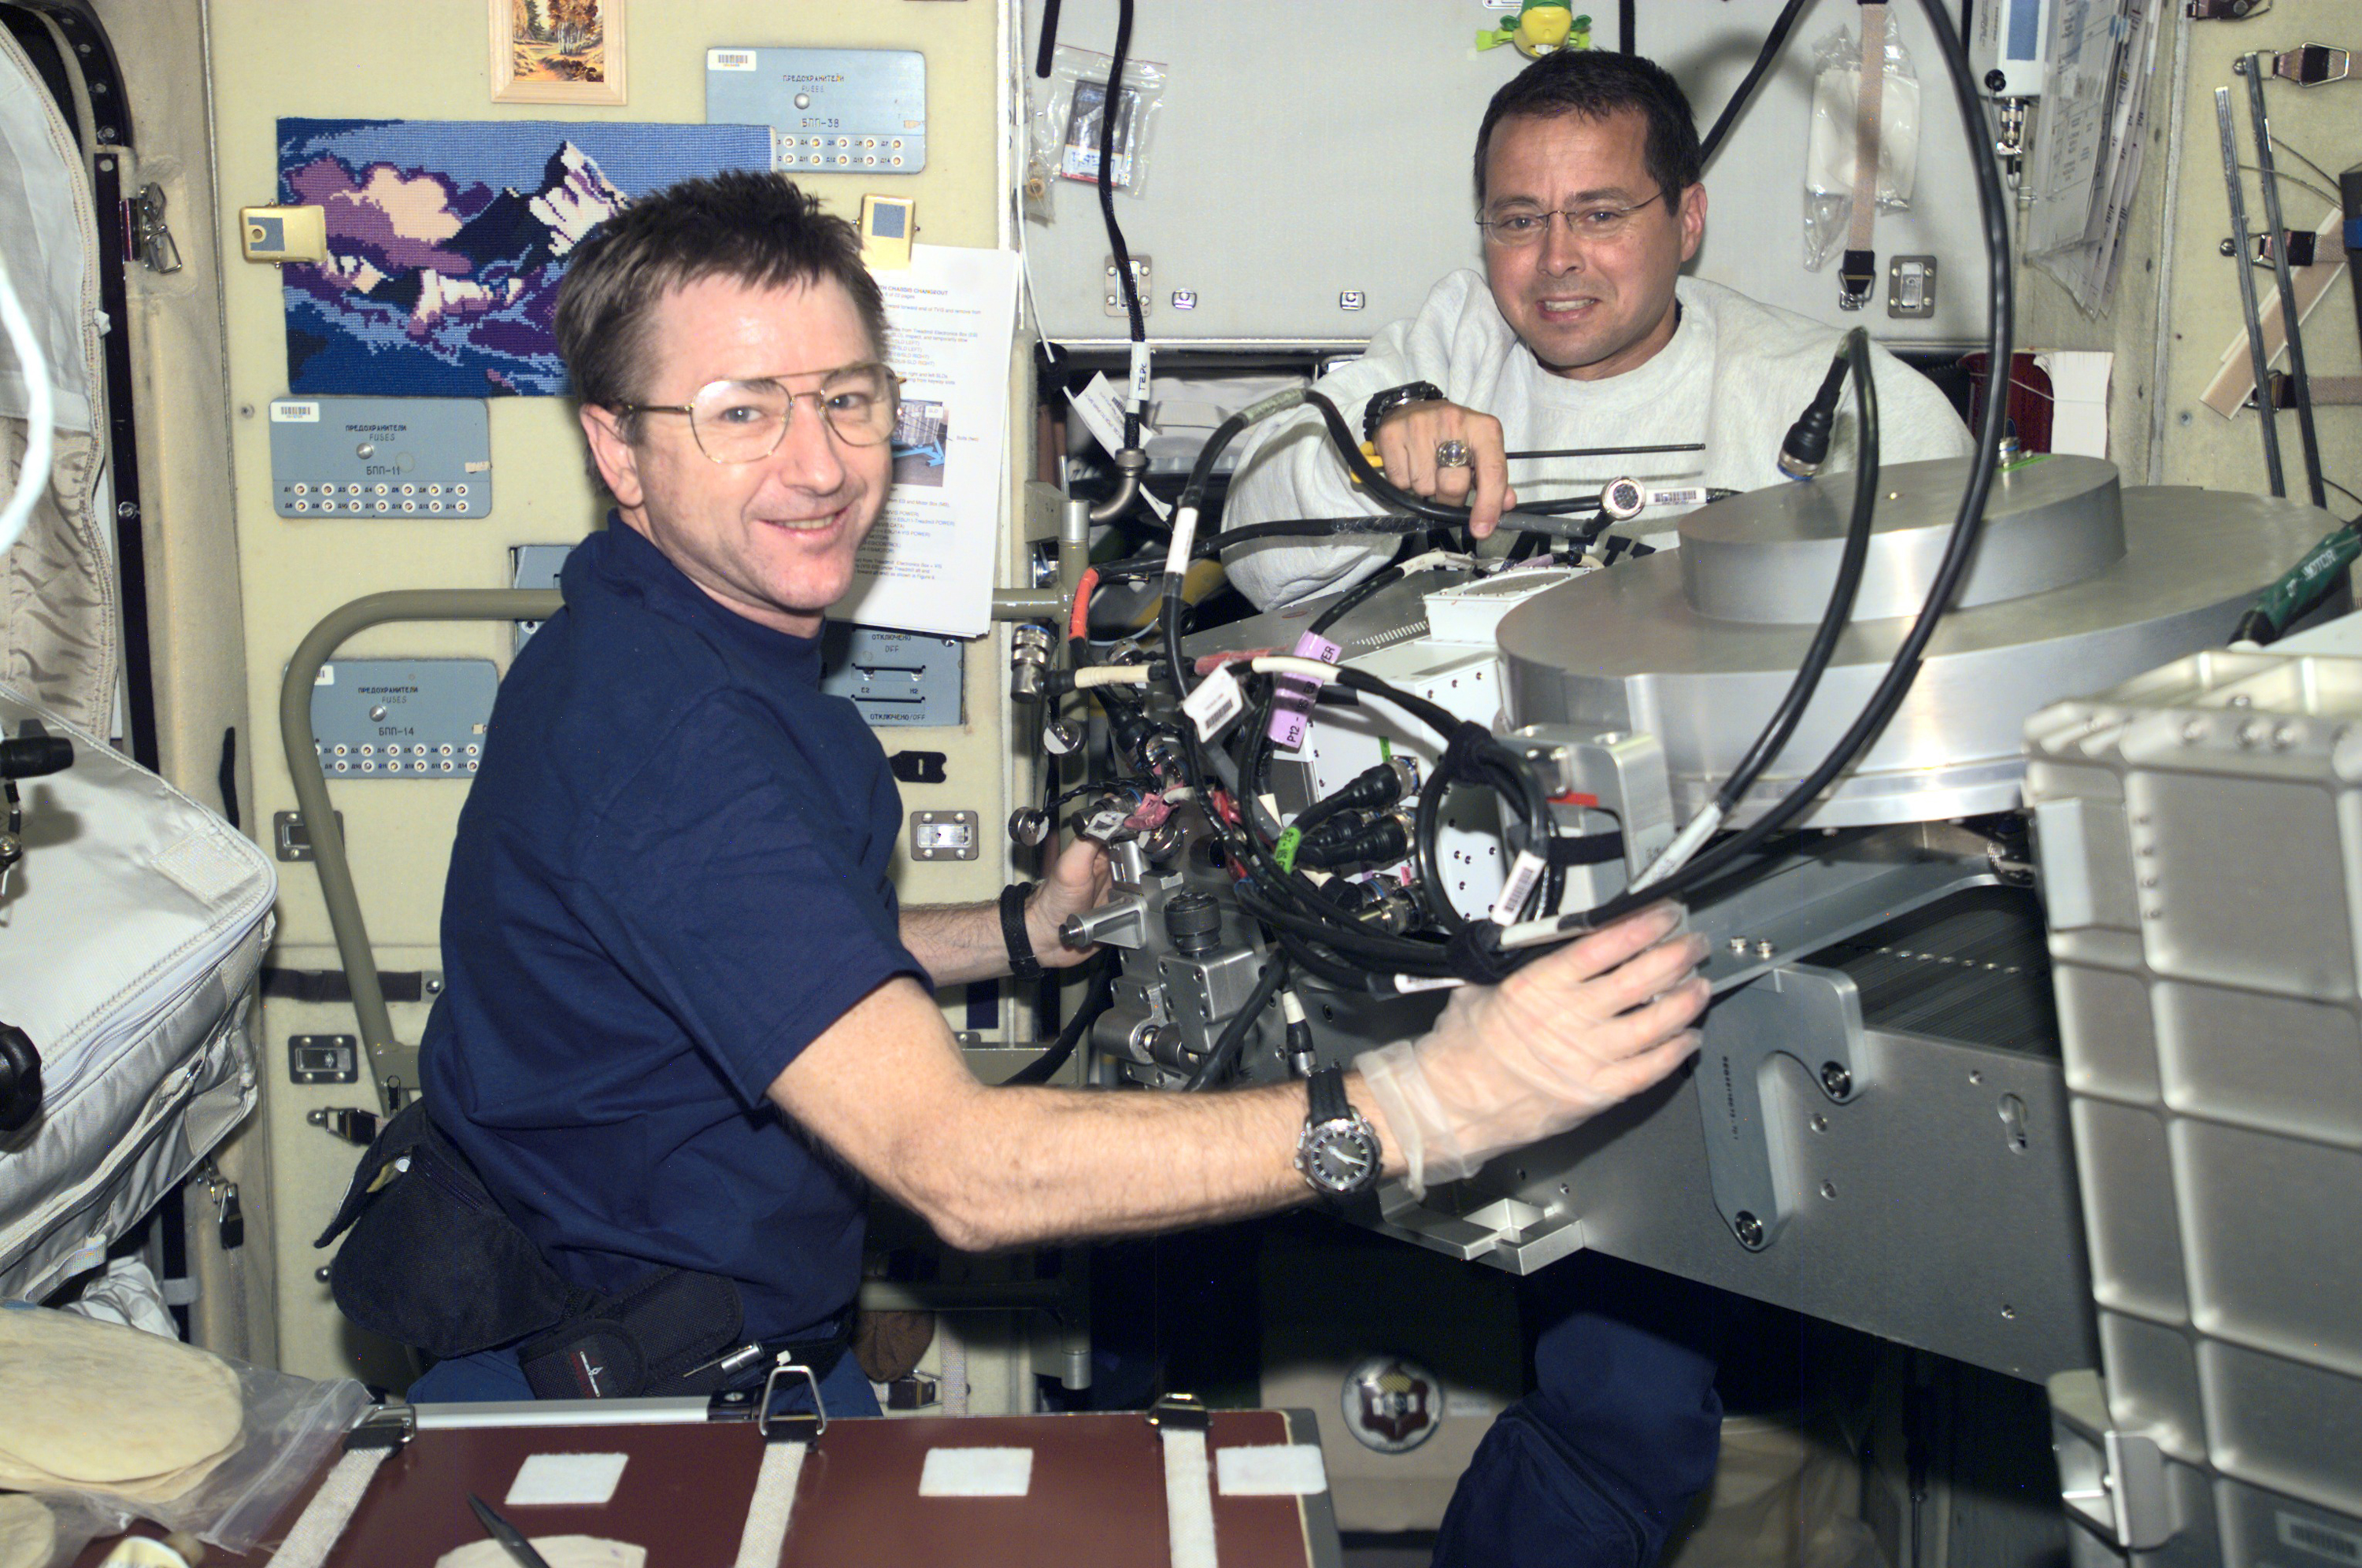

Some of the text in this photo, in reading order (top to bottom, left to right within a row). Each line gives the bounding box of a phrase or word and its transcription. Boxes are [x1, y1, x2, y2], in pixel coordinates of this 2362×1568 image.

[802, 118, 839, 128] БПП-38
[1138, 363, 1147, 391] TEPC
[366, 466, 401, 475] БПП-11
[1287, 726, 1300, 742] P12
[1303, 682, 1316, 693] EB
[379, 727, 414, 736] БПП-14
